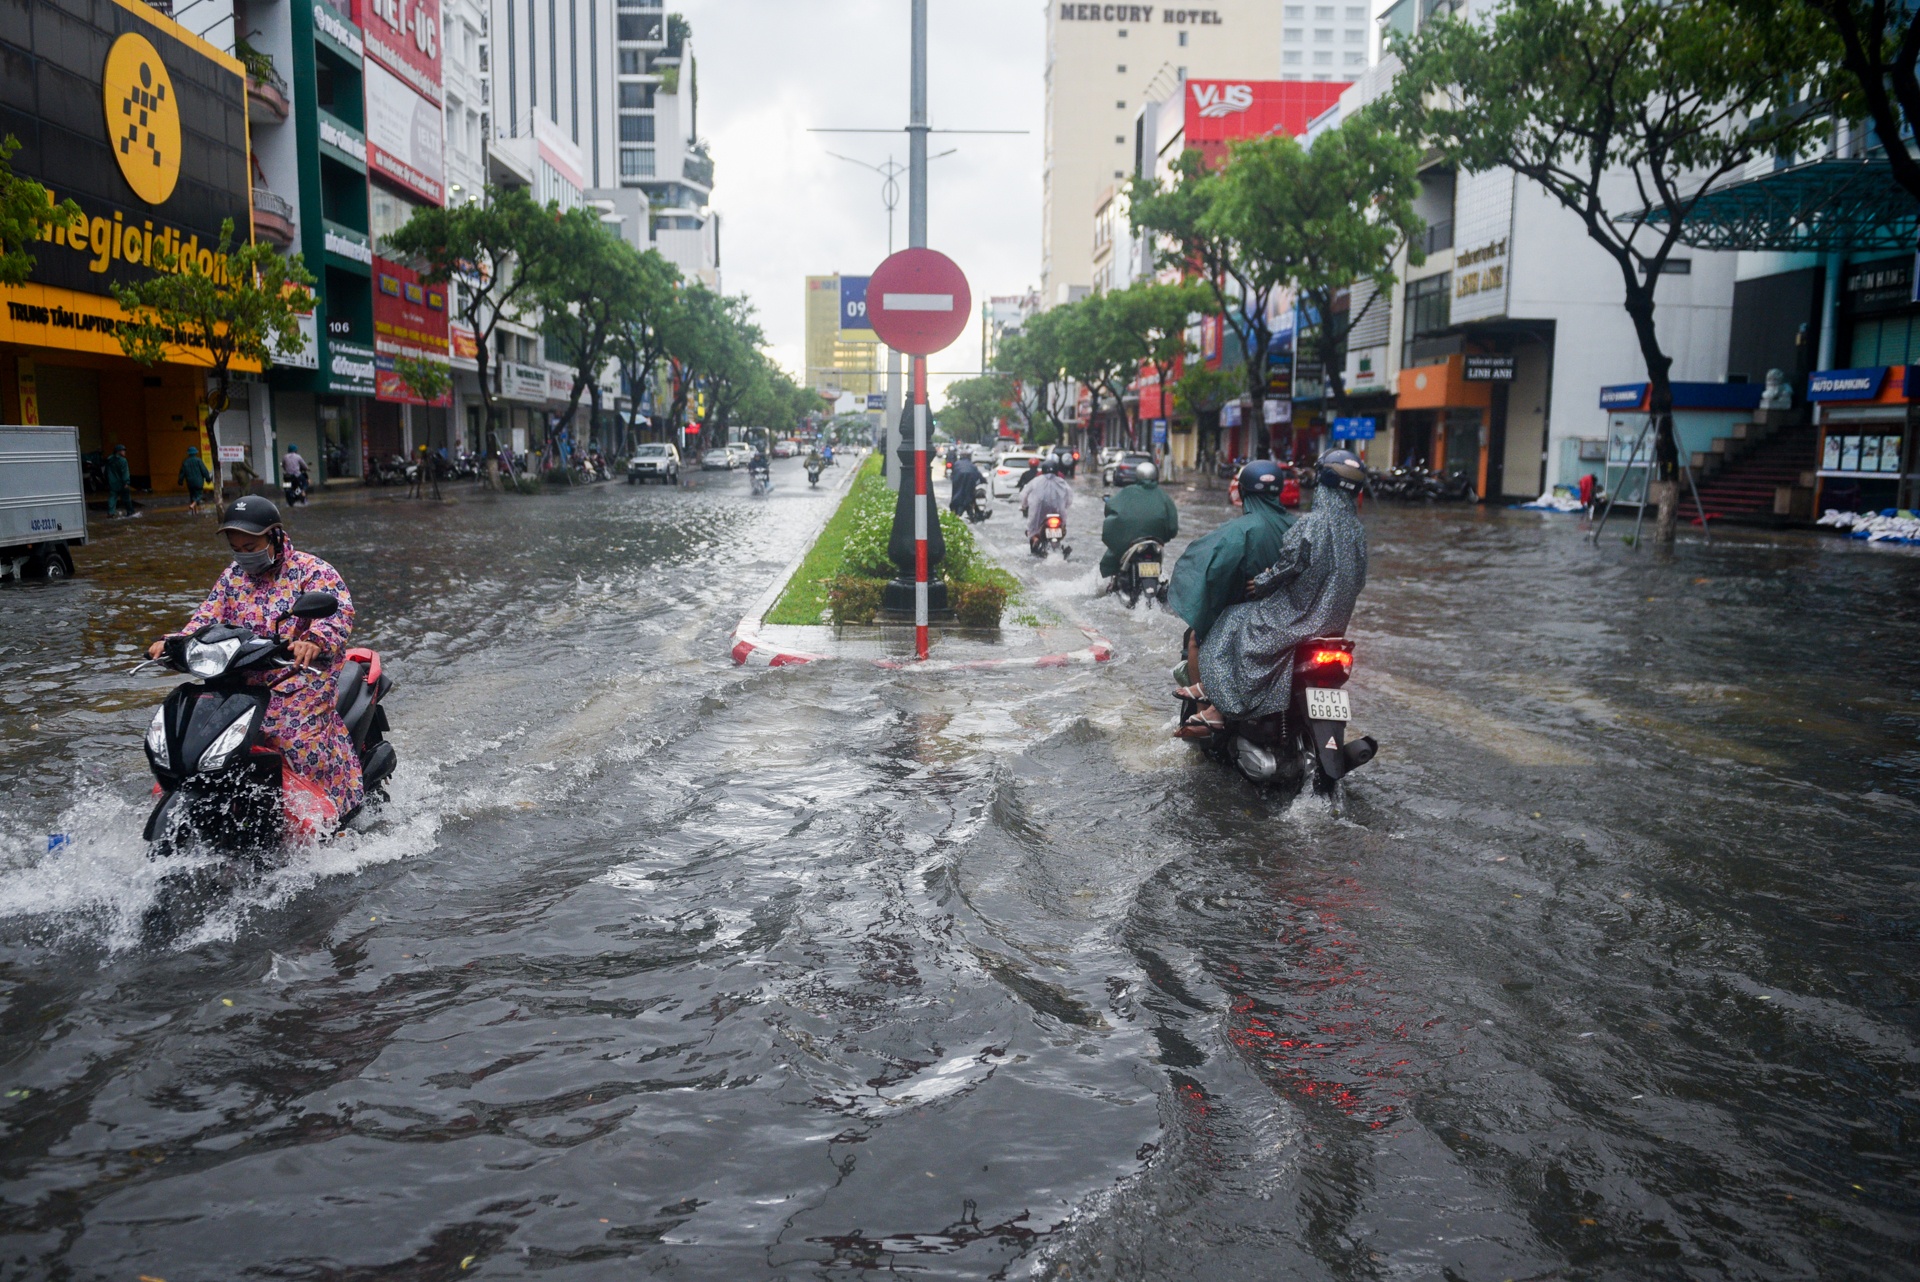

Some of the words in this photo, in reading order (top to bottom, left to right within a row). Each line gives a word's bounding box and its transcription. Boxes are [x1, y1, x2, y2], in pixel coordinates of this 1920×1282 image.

[1060, 3, 1154, 23] MERCURY
[1163, 9, 1223, 25] HOTEL
[1191, 83, 1254, 110] VUS
[34, 188, 243, 292] hegioididon
[7, 301, 49, 326] TRUNG
[49, 305, 75, 330] TÂM
[75, 312, 115, 334] LAPTOP
[329, 322, 350, 333] 106
[1468, 368, 1491, 379] LINH
[1493, 368, 1513, 379] ANH
[1811, 380, 1833, 392] AUTO
[1833, 378, 1870, 391] BANKING
[1313, 690, 1342, 705] 43-C1
[1310, 703, 1349, 719] 668.59
